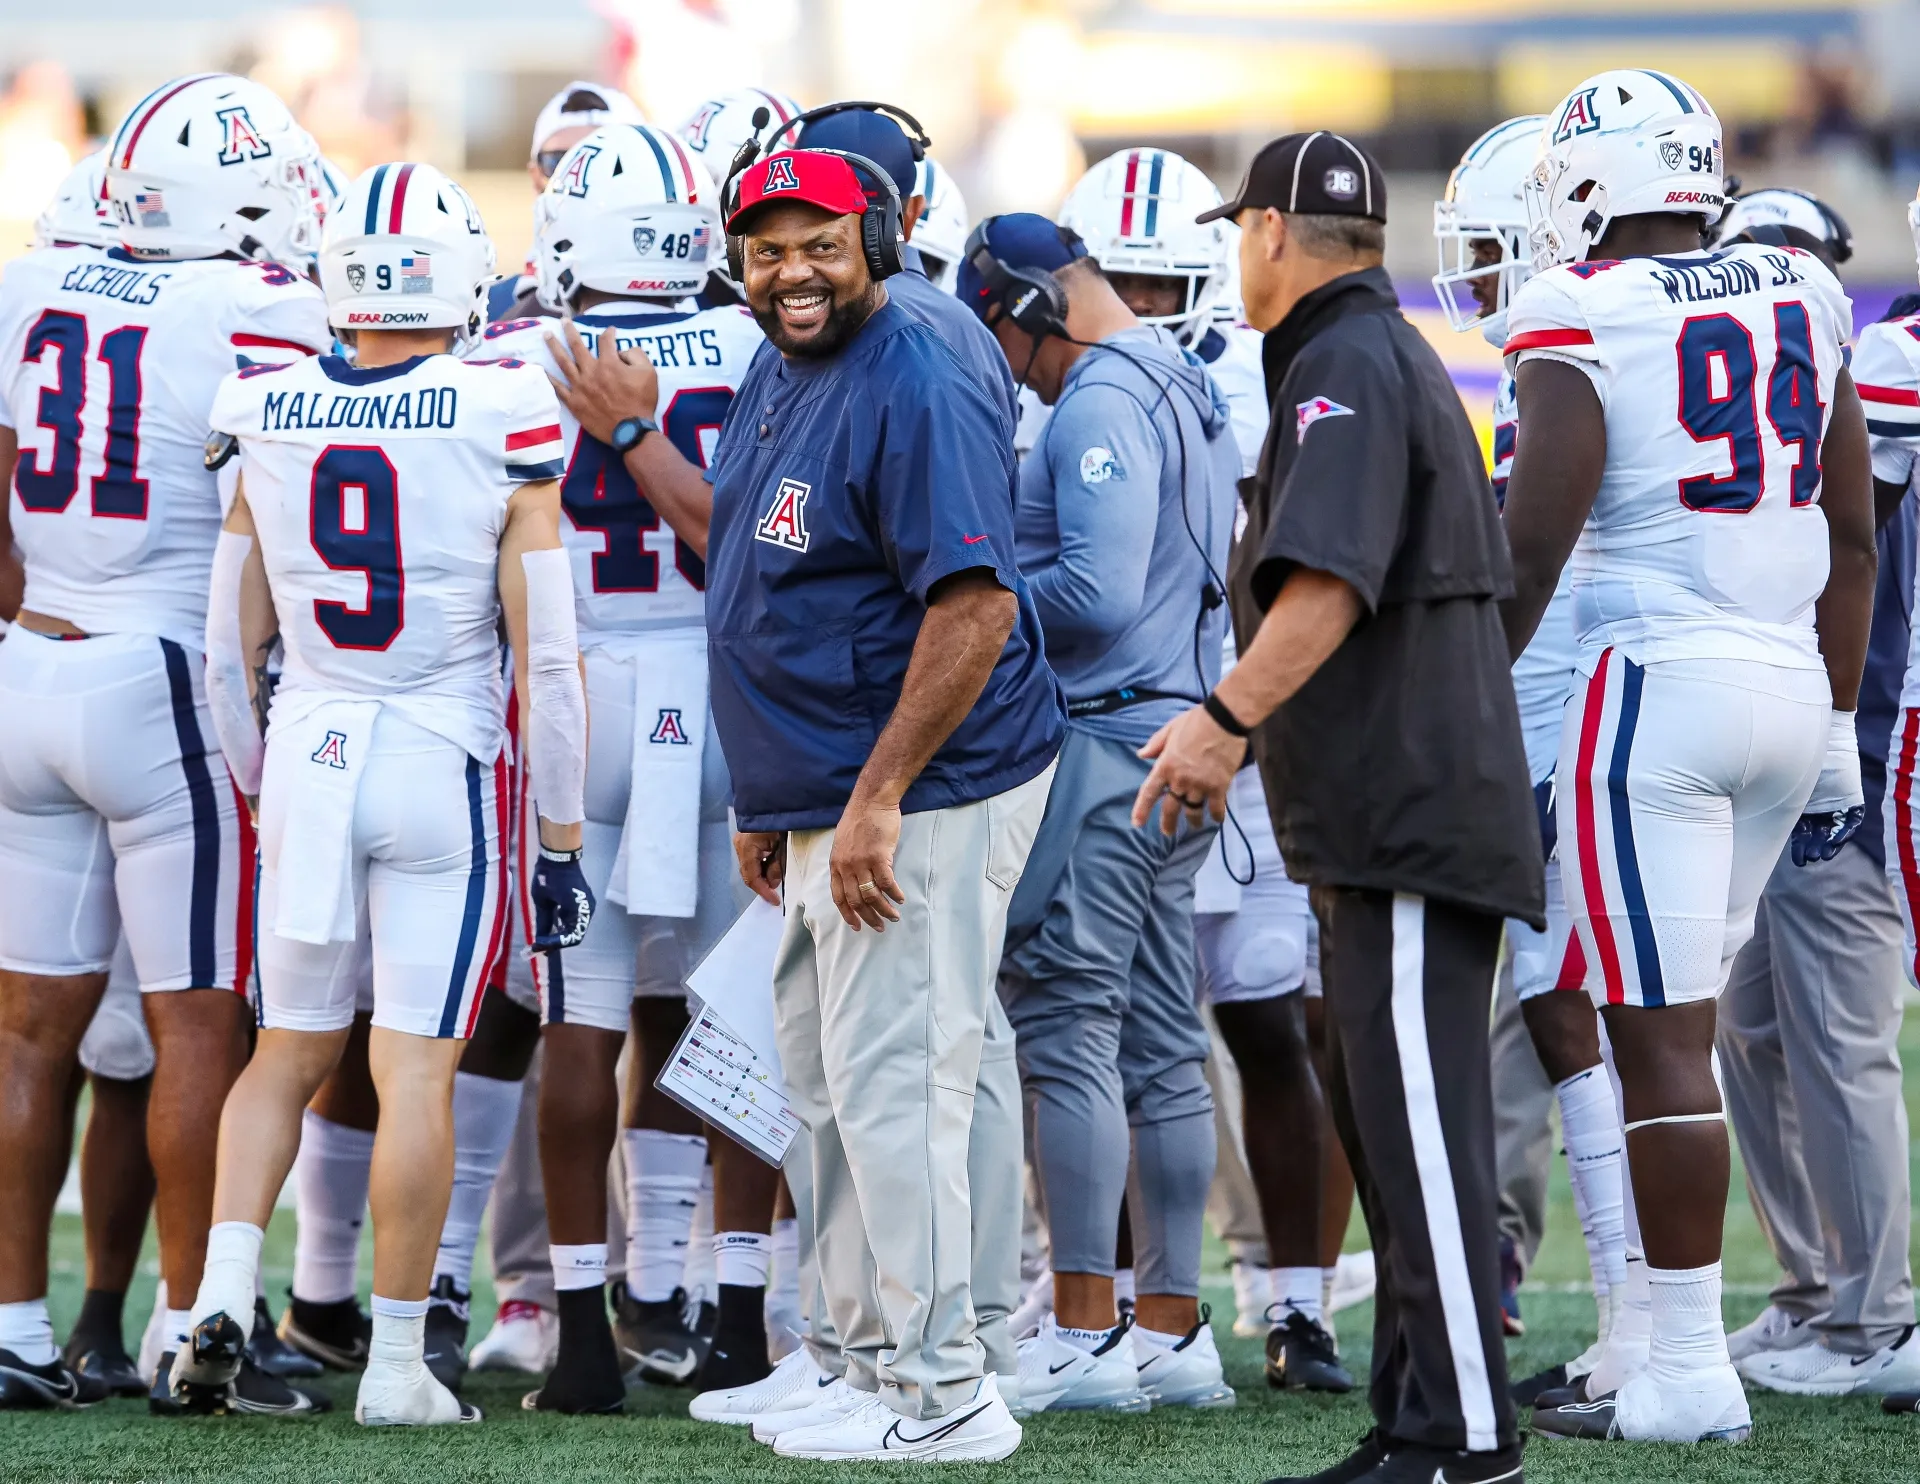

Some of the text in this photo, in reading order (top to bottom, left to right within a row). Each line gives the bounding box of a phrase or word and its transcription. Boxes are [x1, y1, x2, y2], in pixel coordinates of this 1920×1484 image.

[216, 106, 271, 166] A
[1552, 86, 1601, 147] A
[553, 144, 602, 198] A
[762, 156, 800, 195] A
[1688, 145, 1713, 173] 94
[661, 233, 690, 258] 48
[376, 264, 392, 290] 9
[1649, 258, 1760, 303] WILSON
[15, 308, 149, 521] 31
[262, 386, 457, 431] MALDONADO
[1676, 300, 1826, 514] 94
[755, 477, 811, 553] A
[310, 444, 404, 651] 9
[650, 709, 688, 744] A
[312, 731, 348, 769] A
[1062, 1328, 1110, 1341] JORDA
